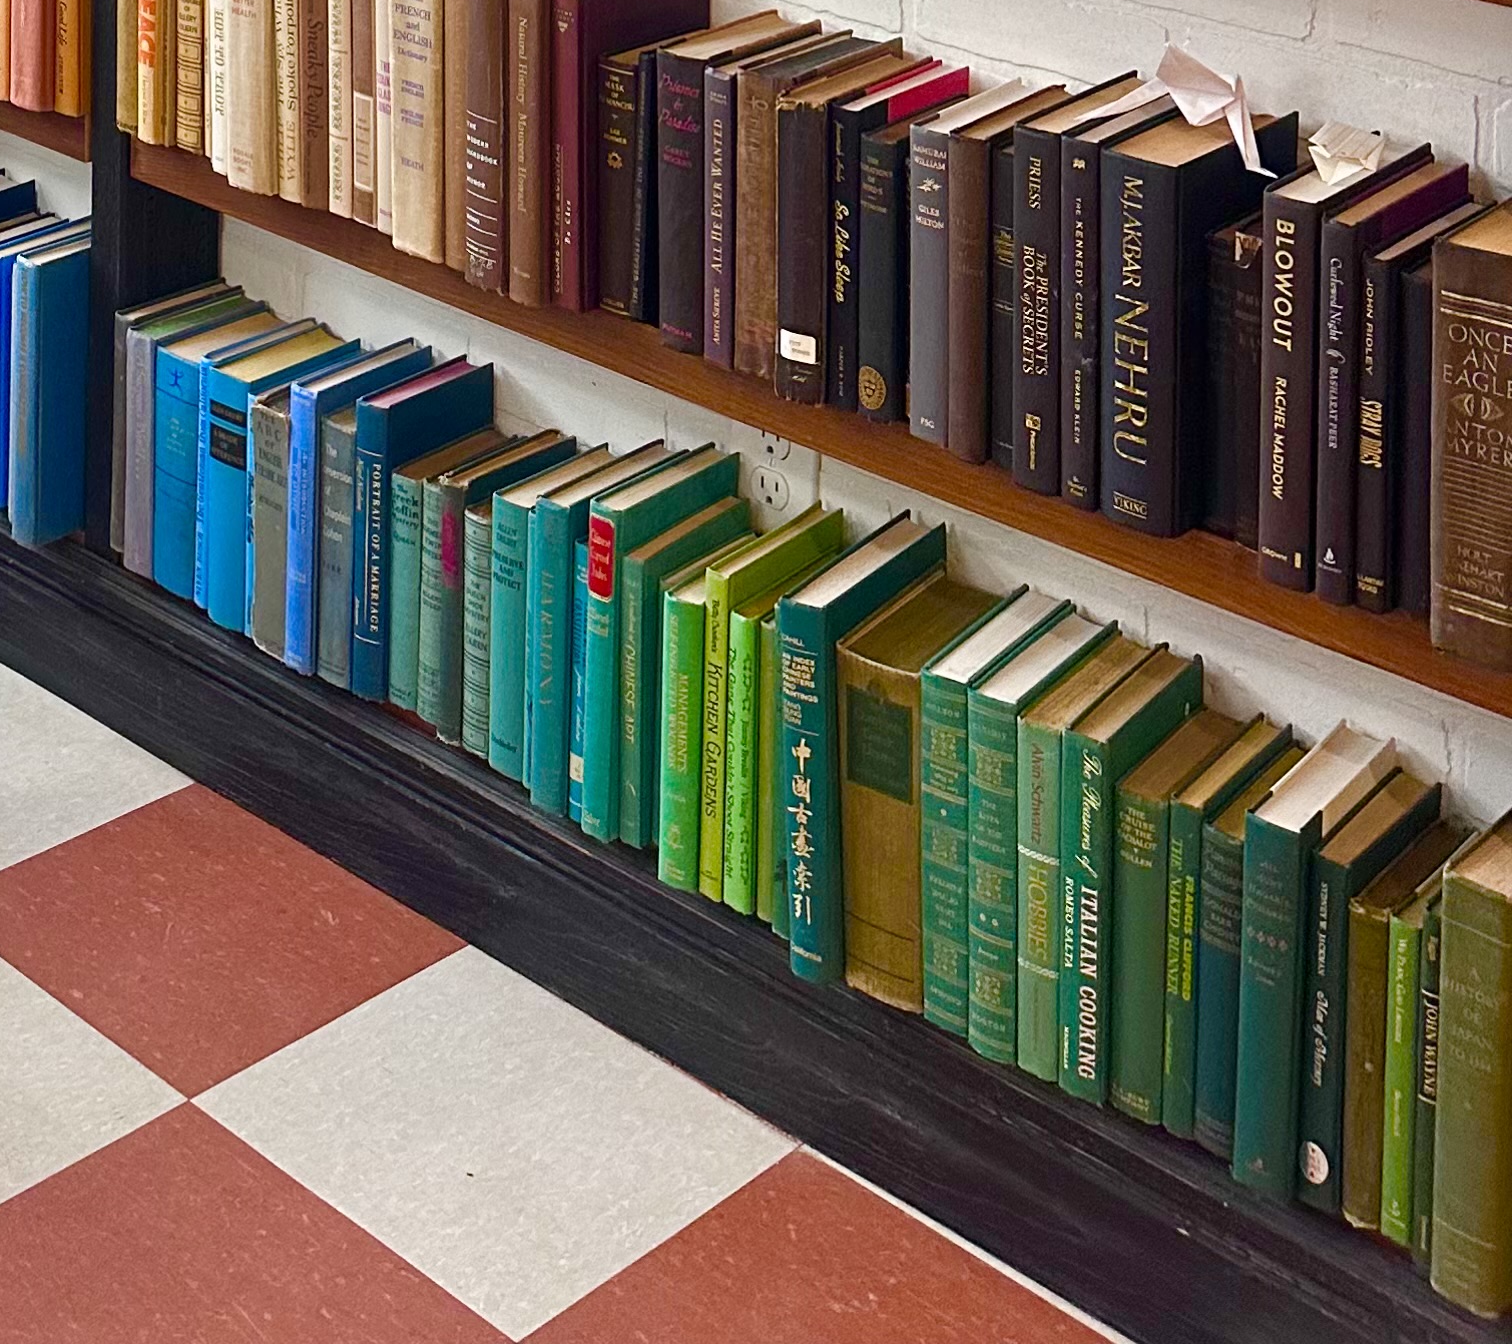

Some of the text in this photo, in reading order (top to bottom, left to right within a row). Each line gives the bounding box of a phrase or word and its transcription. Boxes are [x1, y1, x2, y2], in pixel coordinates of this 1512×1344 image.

[394, 29, 432, 48] ENGLISH
[395, 4, 431, 20] FRENCH
[305, 18, 324, 139] Sneaky People
[1028, 156, 1042, 210] PRIESS
[1113, 175, 1150, 465] M.J. AKBAR NEHRU
[1272, 218, 1296, 500] BLOWOUT RACHEL MADDOW
[1448, 322, 1512, 358] ONCE
[1463, 351, 1498, 374] AN
[1359, 278, 1383, 469] JOHN RIDLEY STRAY DOGS
[1443, 362, 1512, 400] EAGLE
[1113, 494, 1148, 516] VIKING
[706, 662, 723, 818] KITCHEN GARDENS
[1028, 865, 1048, 961] HOBBIES
[1064, 876, 1075, 969] ROMEO SALTA
[1075, 748, 1102, 1080] The Pleasures of ITALIAN COOKING
[1167, 838, 1183, 995] THE NAKED RUNNER
[1424, 1004, 1438, 1098] JOHN WAYNE
